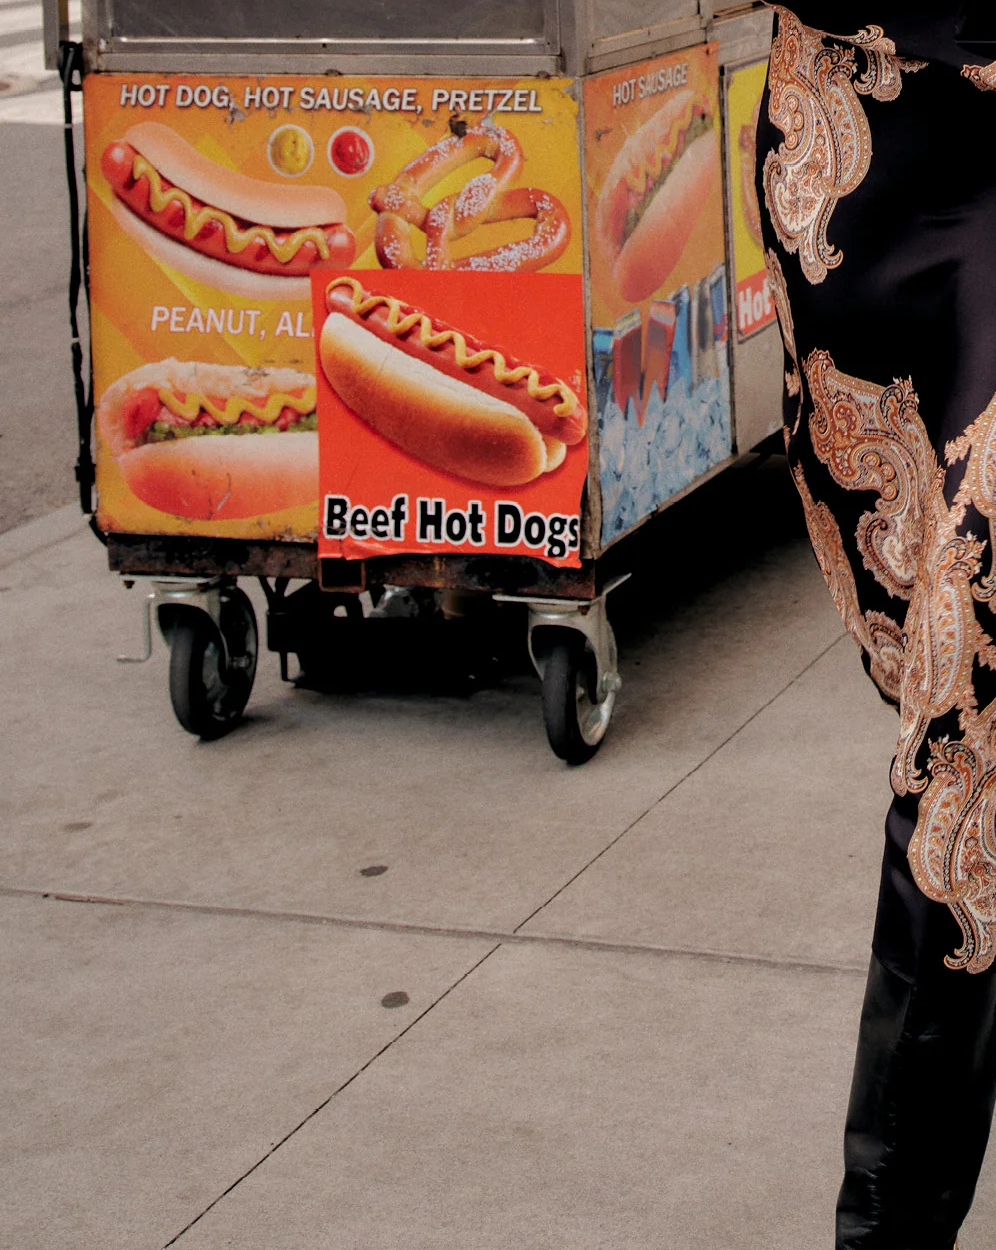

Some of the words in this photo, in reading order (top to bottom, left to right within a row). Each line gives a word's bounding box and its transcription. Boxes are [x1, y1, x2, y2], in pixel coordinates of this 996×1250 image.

[120, 84, 170, 107] HOT
[175, 85, 235, 110] DOG,
[244, 86, 295, 108] HOT
[300, 87, 423, 114] SAUSAGE,
[431, 89, 542, 112] PRETZEL
[613, 78, 636, 107] HOT
[638, 62, 688, 99] SAUSAGE
[151, 305, 266, 340] PEANUT,
[274, 311, 314, 338] AL
[323, 493, 408, 541] Beef
[416, 497, 486, 546] Hot
[494, 501, 580, 560] Dogs
